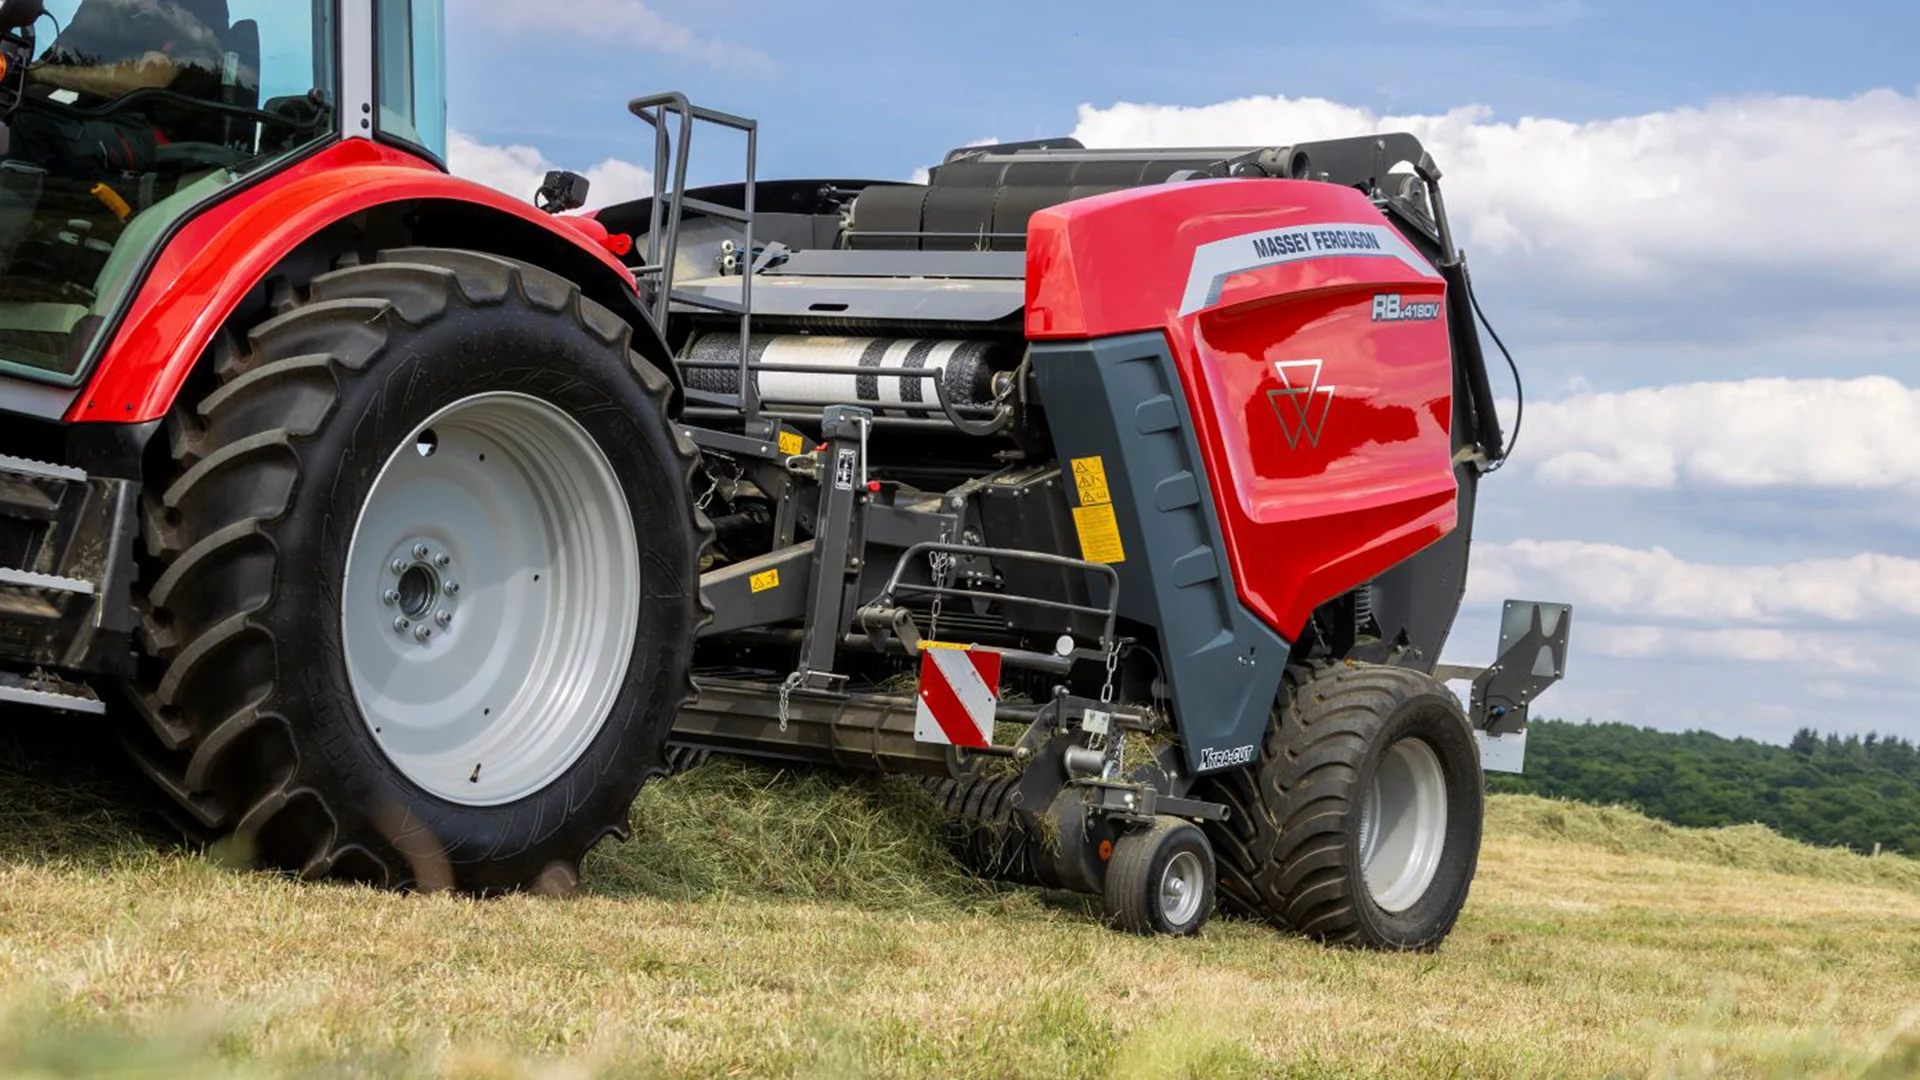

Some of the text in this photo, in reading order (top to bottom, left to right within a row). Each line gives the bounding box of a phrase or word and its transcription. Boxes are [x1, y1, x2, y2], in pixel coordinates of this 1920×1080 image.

[1252, 229, 1381, 259] MASSEY FERGUSON
[1197, 744, 1254, 772] XTRA-CUT
